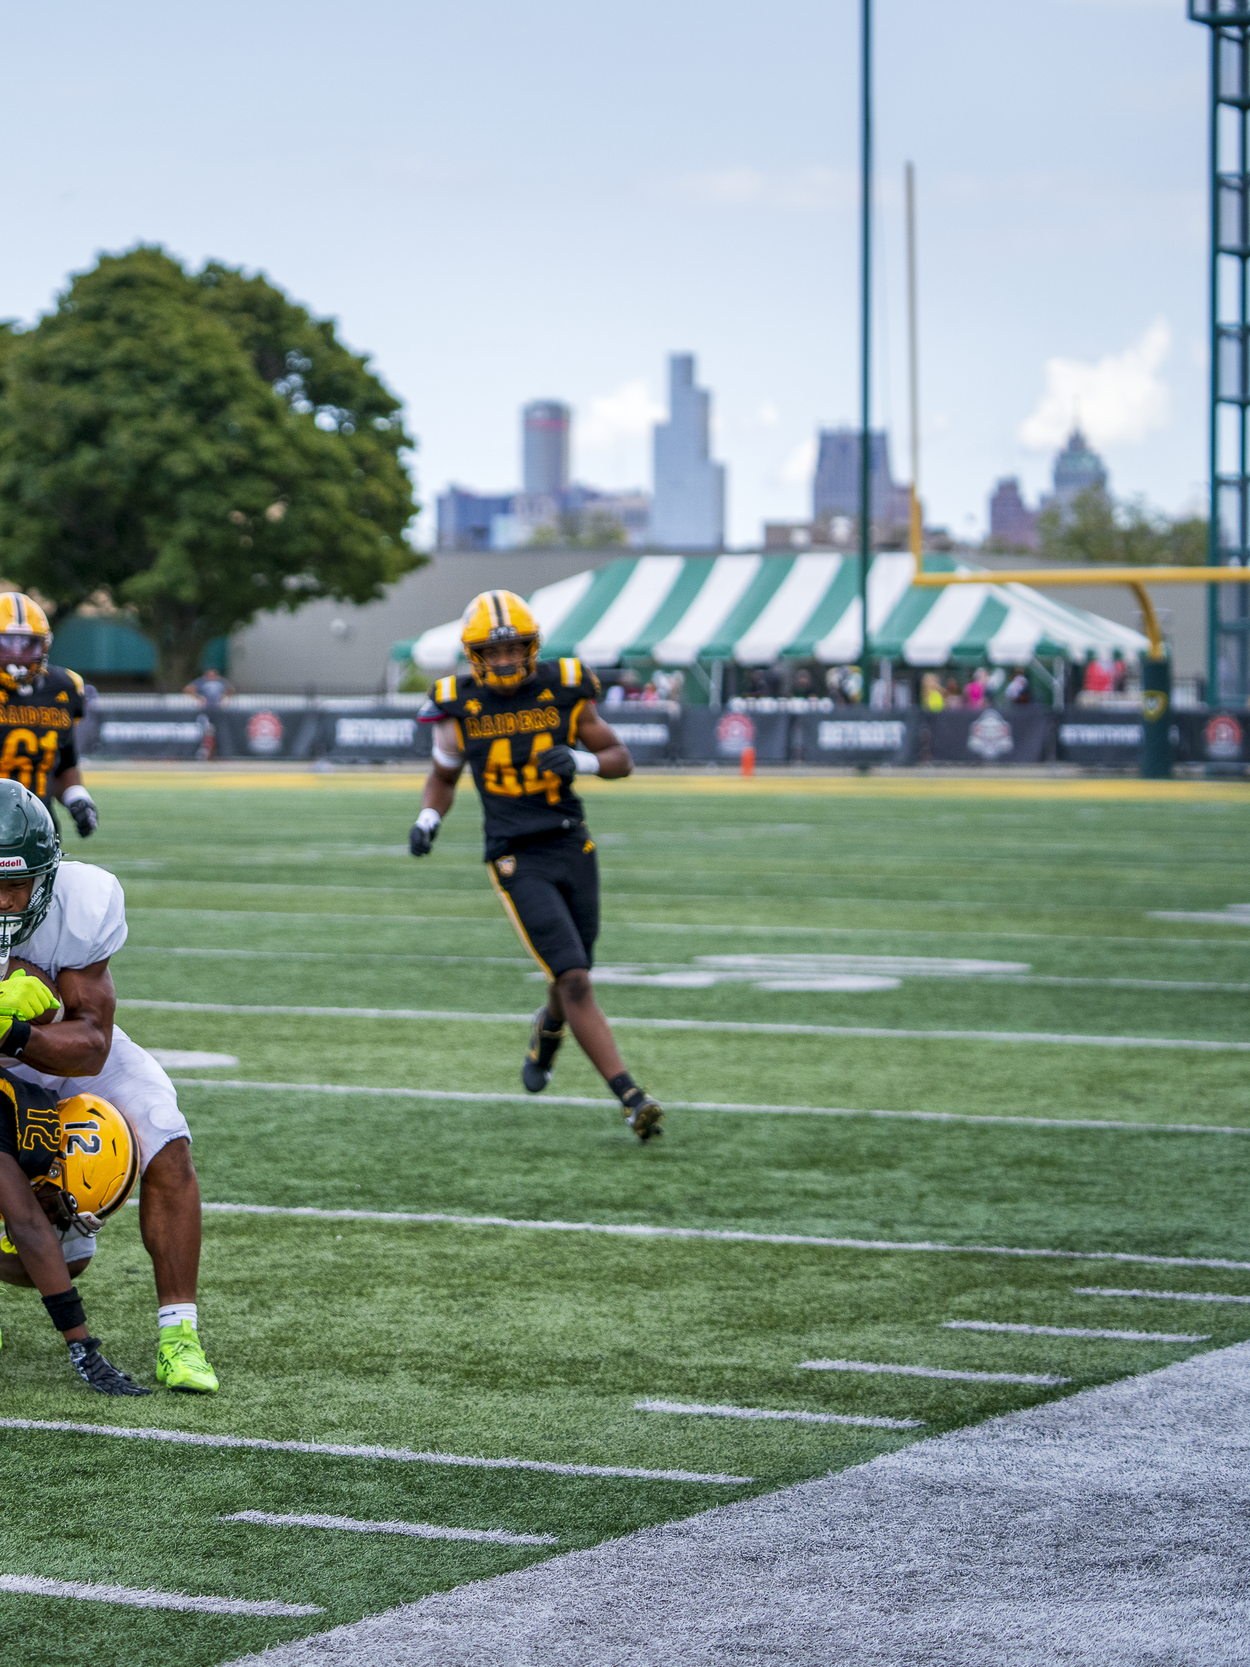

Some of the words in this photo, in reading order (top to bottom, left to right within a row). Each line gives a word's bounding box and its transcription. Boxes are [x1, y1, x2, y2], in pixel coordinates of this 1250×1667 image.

[465, 706, 561, 740] RAIDERS
[483, 732, 563, 805] 44
[23, 1108, 61, 1152] 12
[63, 1120, 102, 1156] 12
